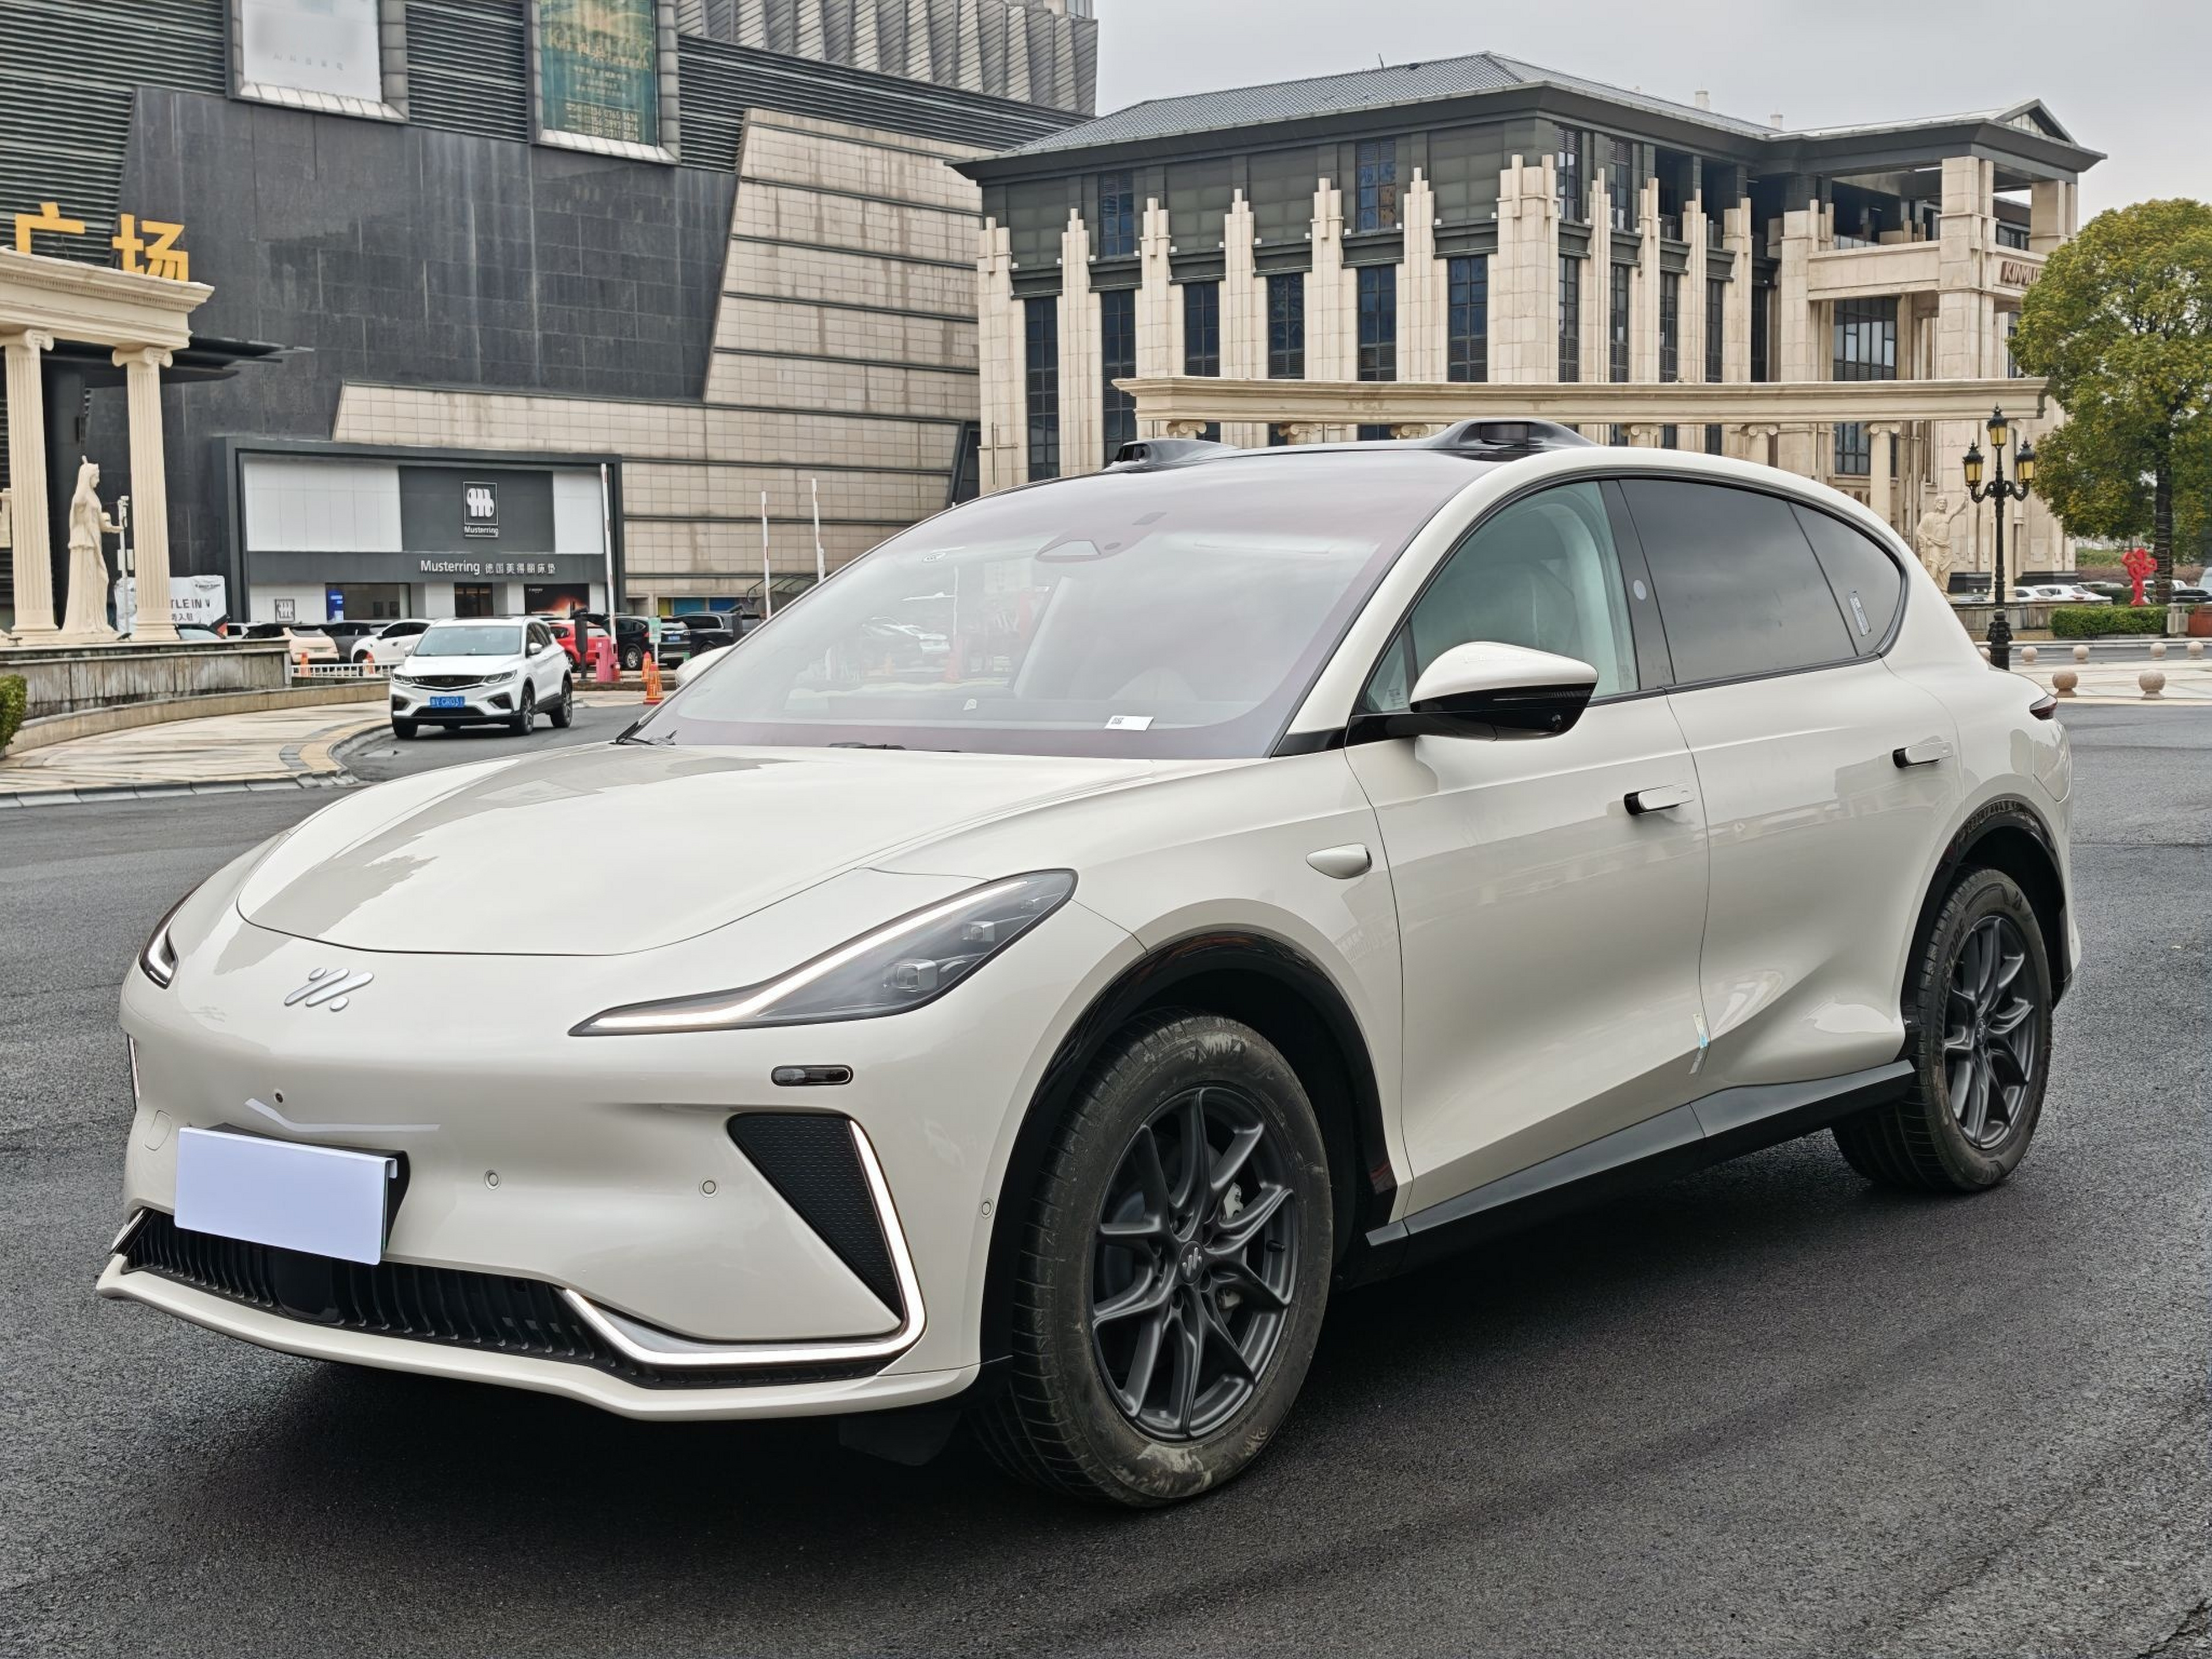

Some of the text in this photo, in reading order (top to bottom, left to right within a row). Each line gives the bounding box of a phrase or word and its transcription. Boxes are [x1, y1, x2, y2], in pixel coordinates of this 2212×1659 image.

[15, 202, 189, 282] 广场
[464, 525, 499, 537] Musterring
[421, 560, 480, 575] Musterring
